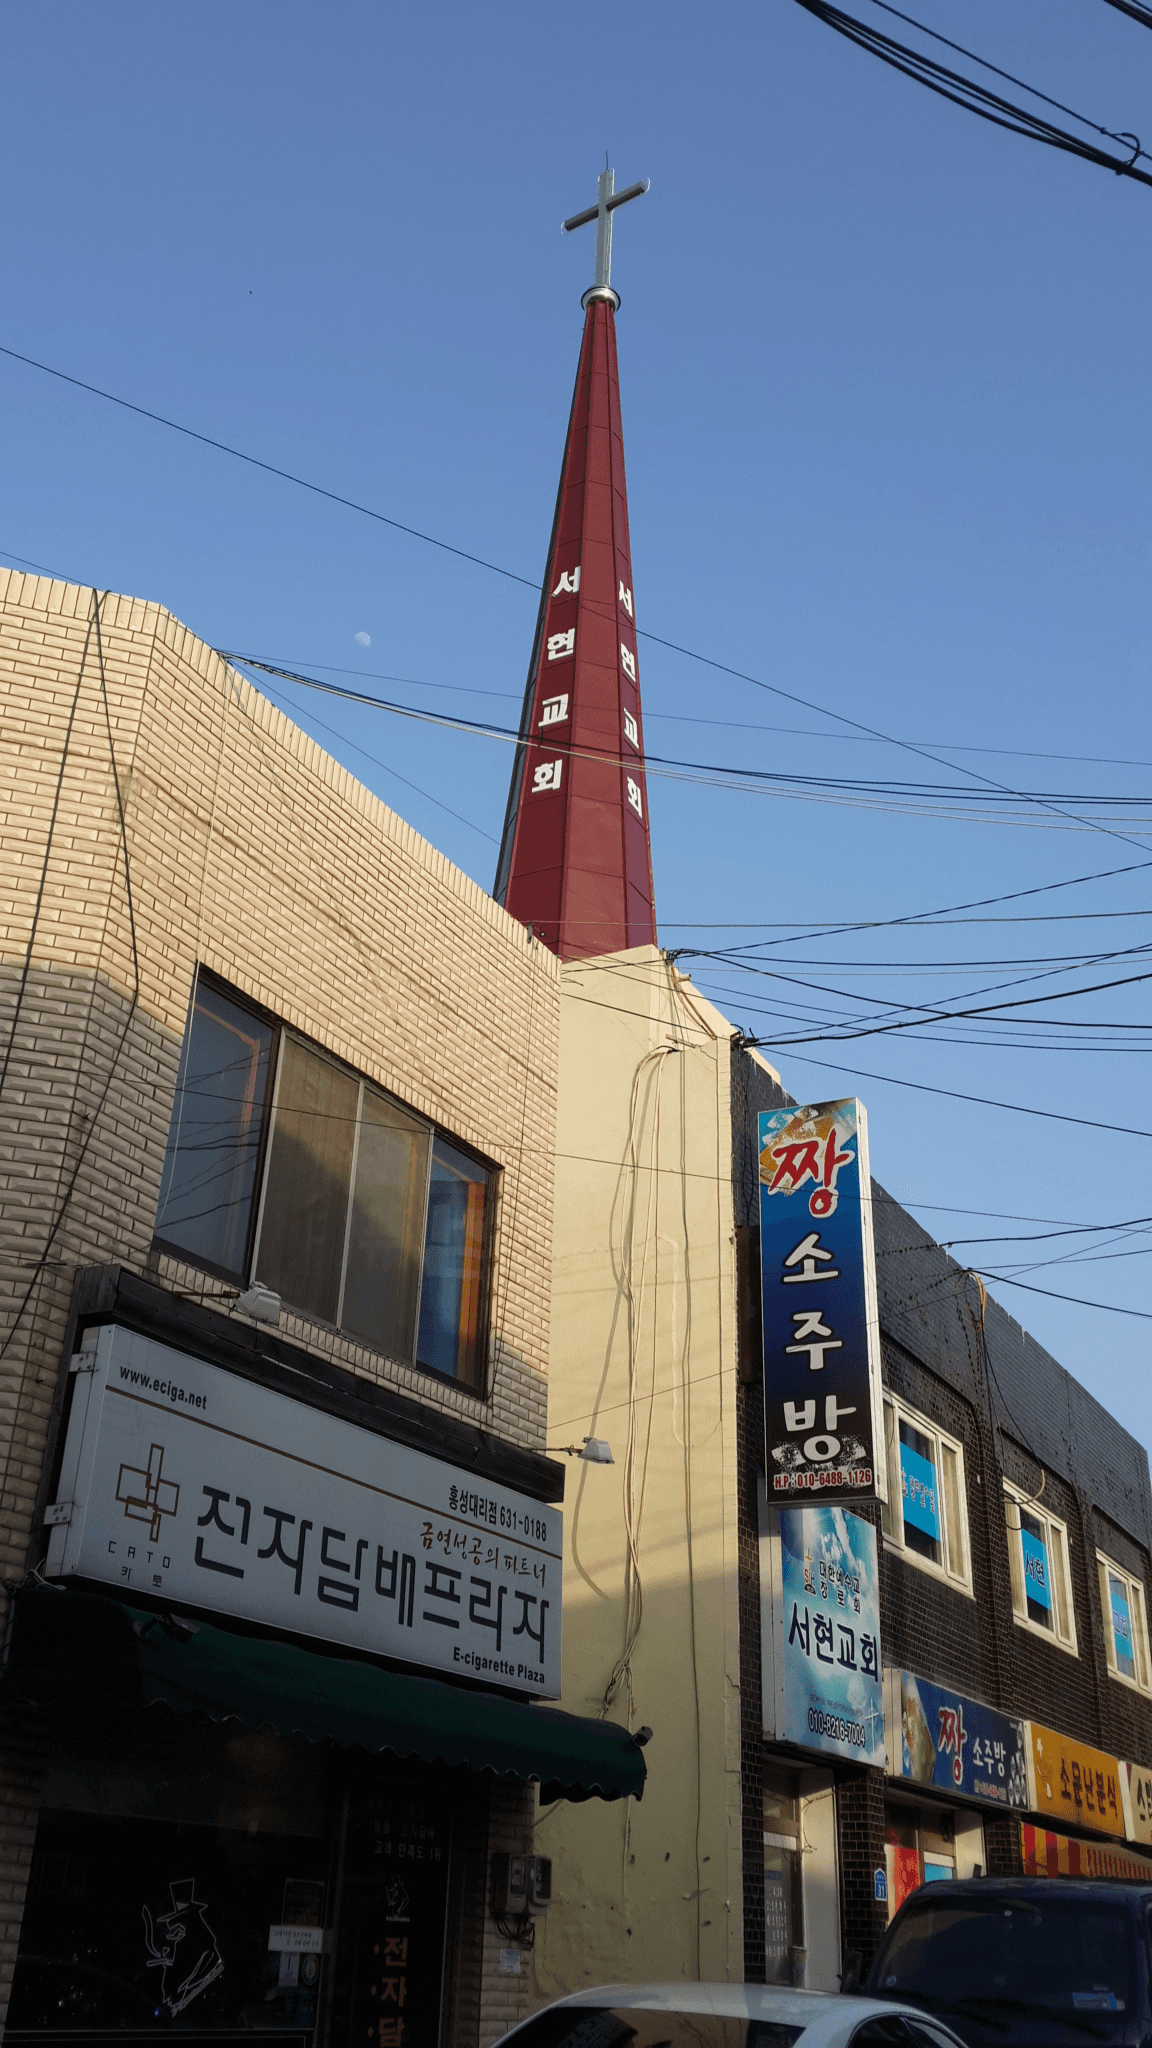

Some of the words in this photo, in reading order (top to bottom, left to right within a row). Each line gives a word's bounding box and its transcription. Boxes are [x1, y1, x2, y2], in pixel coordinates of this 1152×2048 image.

[532, 565, 582, 794] 서현교회
[619, 580, 643, 819] 서현교회
[769, 1128, 850, 1216] 짱
[781, 1232, 857, 1462] 소주방
[119, 1365, 207, 1410] www.eciga.net
[797, 1469, 872, 1488] 010-6488-1126
[449, 1485, 497, 1525] 홍성대리점
[500, 1506, 547, 1542] 631-0188
[108, 1540, 170, 1569] CATO
[195, 1485, 549, 1664] 전자담배프라자
[420, 1521, 499, 1570] 금연성공의
[504, 1555, 546, 1588] 파트너
[819, 1560, 860, 1594] 대한예수교
[1025, 1549, 1045, 1588] 서현
[820, 1580, 860, 1616] 장로회
[453, 1646, 515, 1676] E-cigarette
[517, 1664, 545, 1684] Plaza
[788, 1601, 880, 1683] 서현교회
[808, 1707, 866, 1748] 010-8216-7004
[938, 1704, 967, 1785] 짱
[973, 1736, 1007, 1777] 소주방
[1060, 1757, 1117, 1820] 소문난분식
